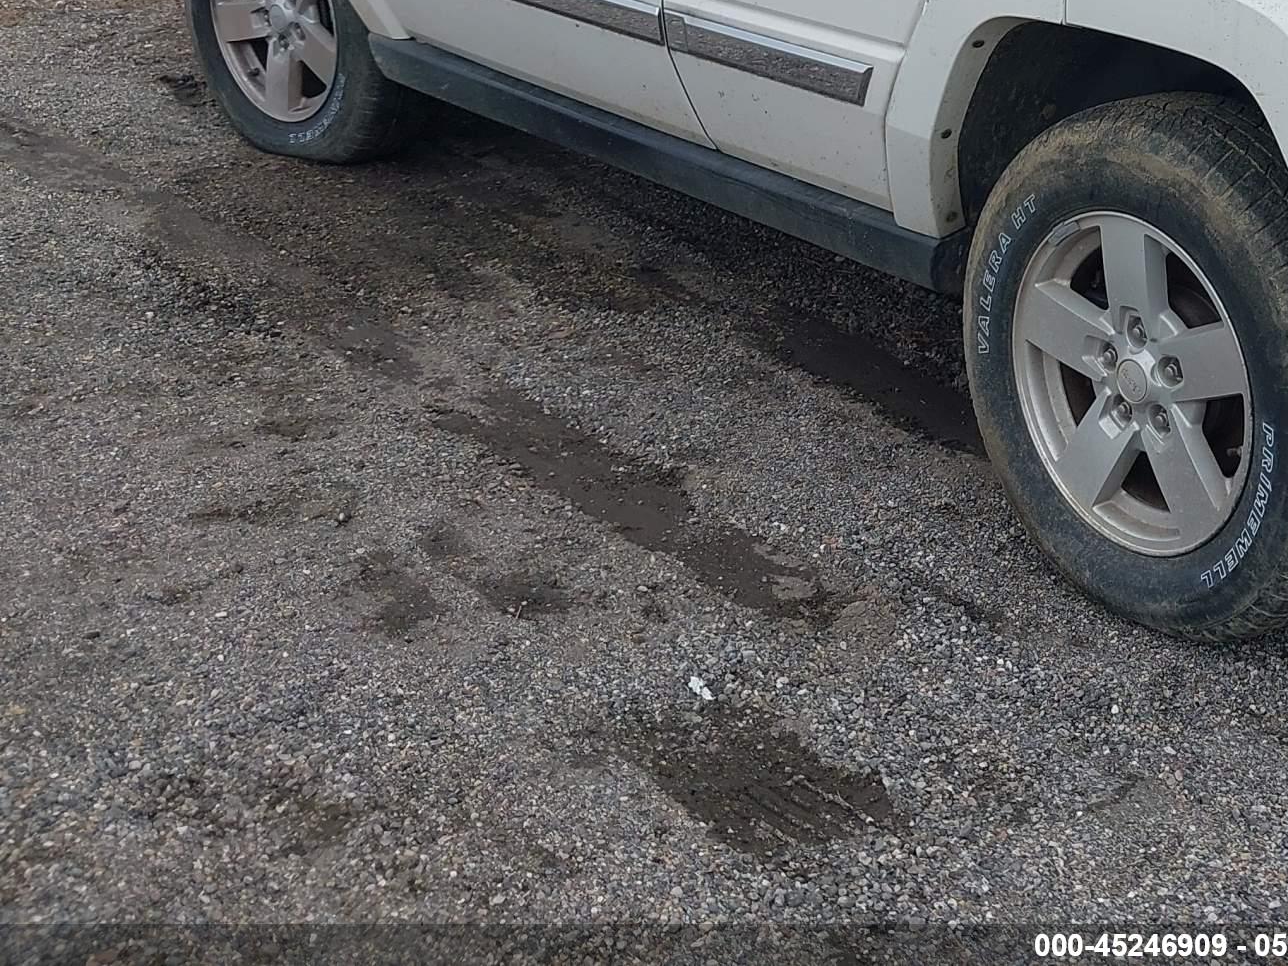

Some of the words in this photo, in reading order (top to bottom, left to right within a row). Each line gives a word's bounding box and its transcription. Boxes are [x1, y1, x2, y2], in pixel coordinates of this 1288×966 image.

[977, 232, 1012, 354] VALERA
[1011, 193, 1036, 230] HT
[1200, 421, 1275, 589] PRIMEWELL
